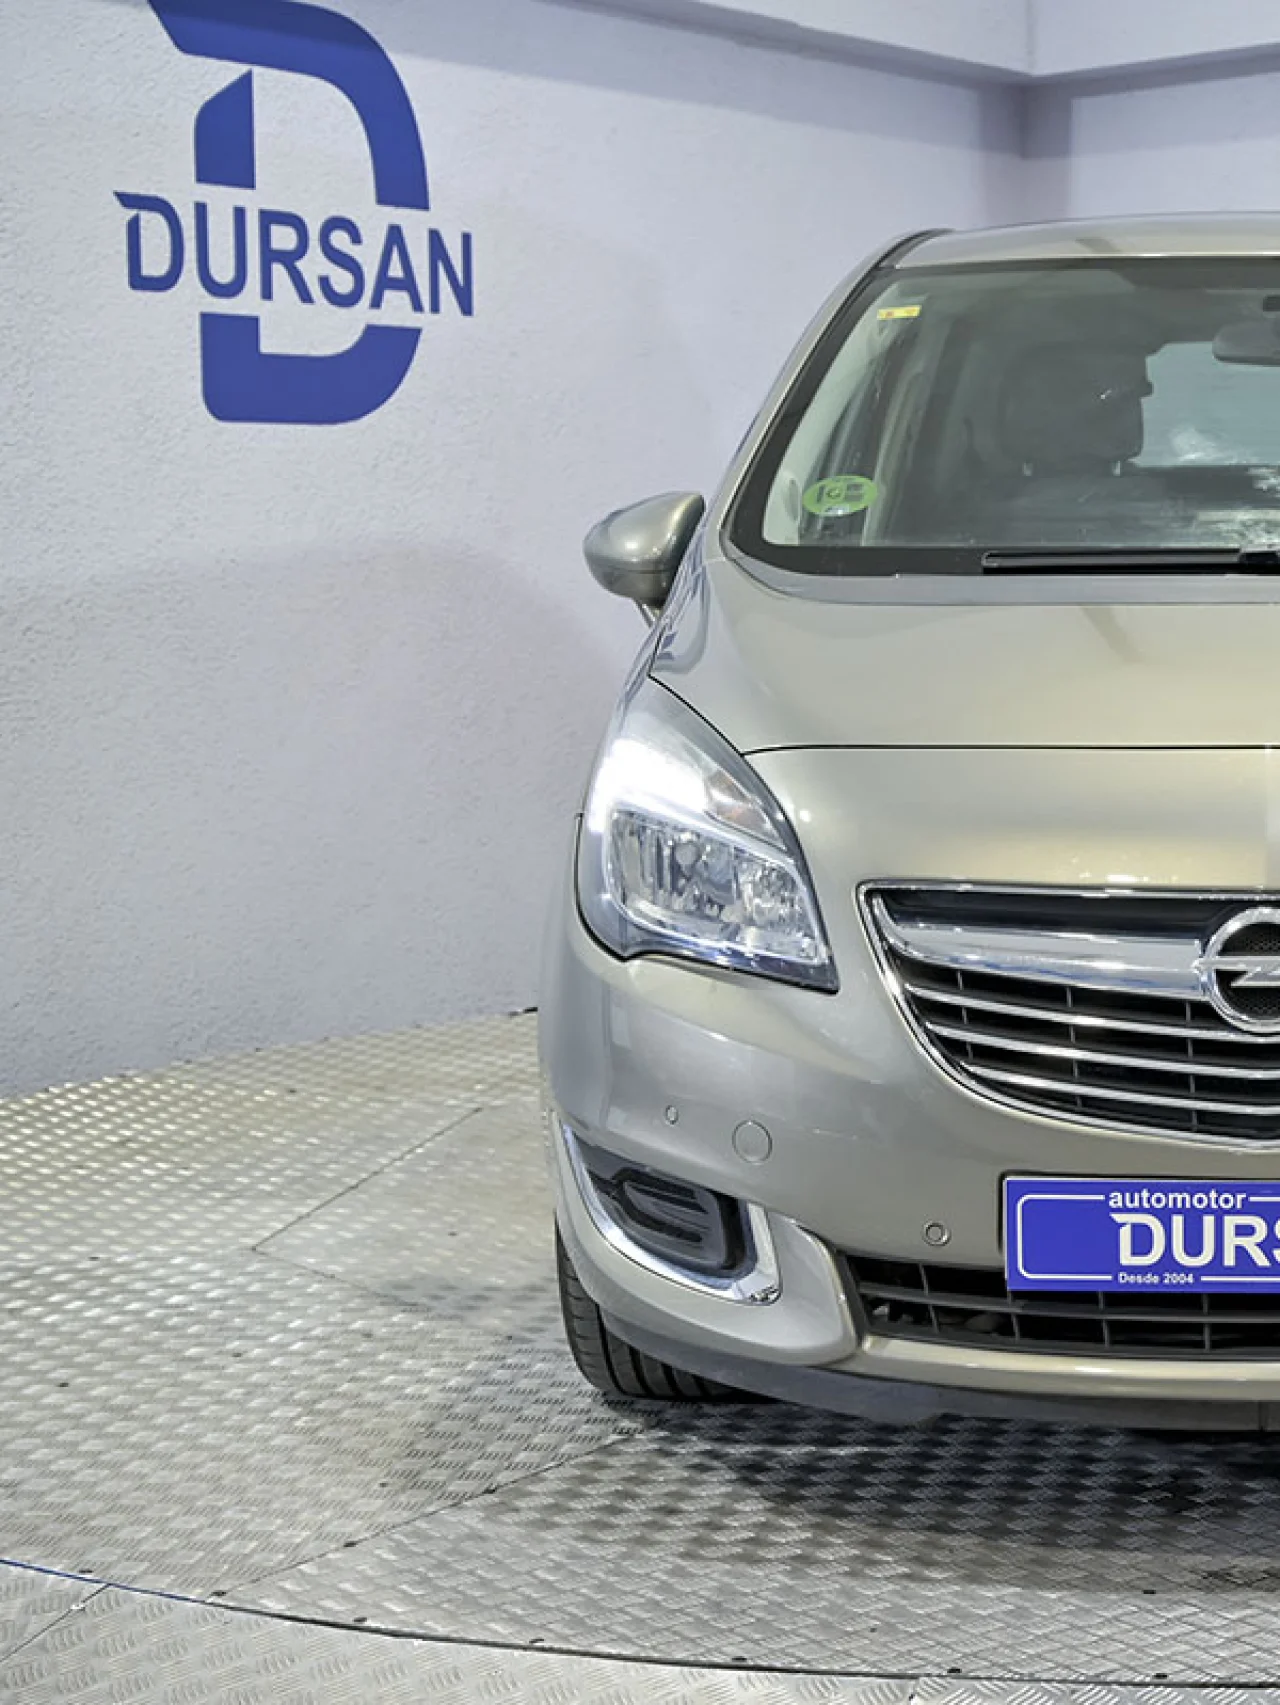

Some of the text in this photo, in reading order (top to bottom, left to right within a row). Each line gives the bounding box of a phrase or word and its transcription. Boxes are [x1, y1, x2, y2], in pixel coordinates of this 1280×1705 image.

[113, 190, 474, 317] DURSAN
[1108, 1188, 1247, 1209] automotor
[1117, 1271, 1194, 1284] Desde 2004
